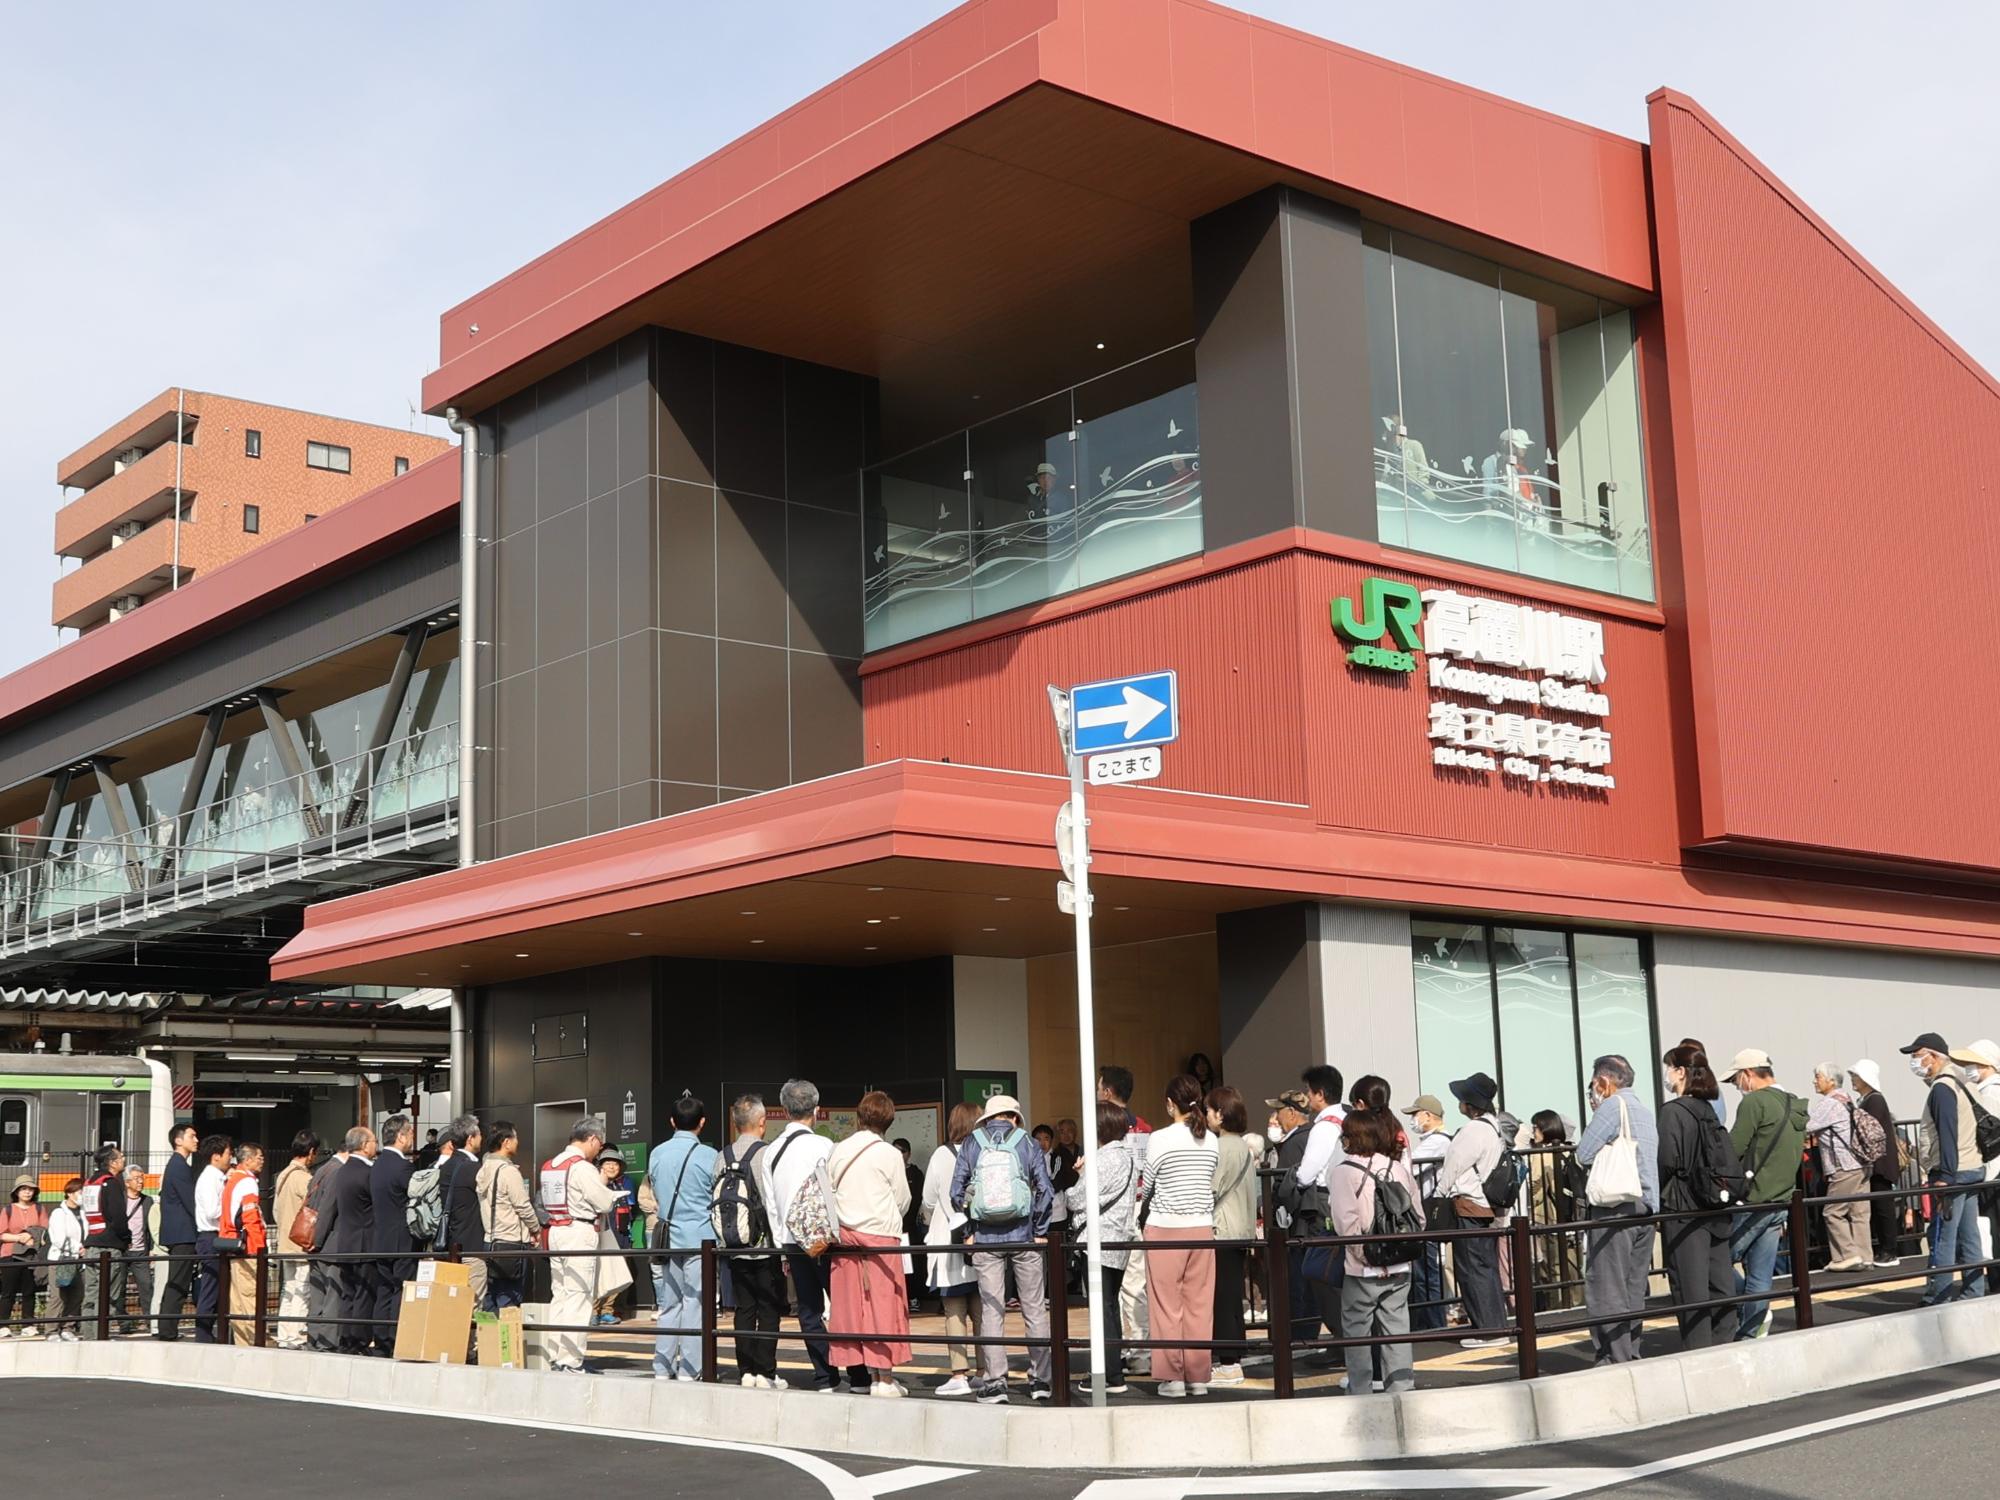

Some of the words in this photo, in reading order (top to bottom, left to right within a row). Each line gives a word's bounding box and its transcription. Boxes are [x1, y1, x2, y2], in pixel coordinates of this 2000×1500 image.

[1331, 577, 1424, 650] JR
[1421, 589, 1607, 684] 高麗川駅
[1428, 657, 1541, 704] Komagawa
[1540, 678, 1610, 716] Station
[1097, 755, 1153, 778] ここまで
[1427, 701, 1612, 767] 埼玉県日高市
